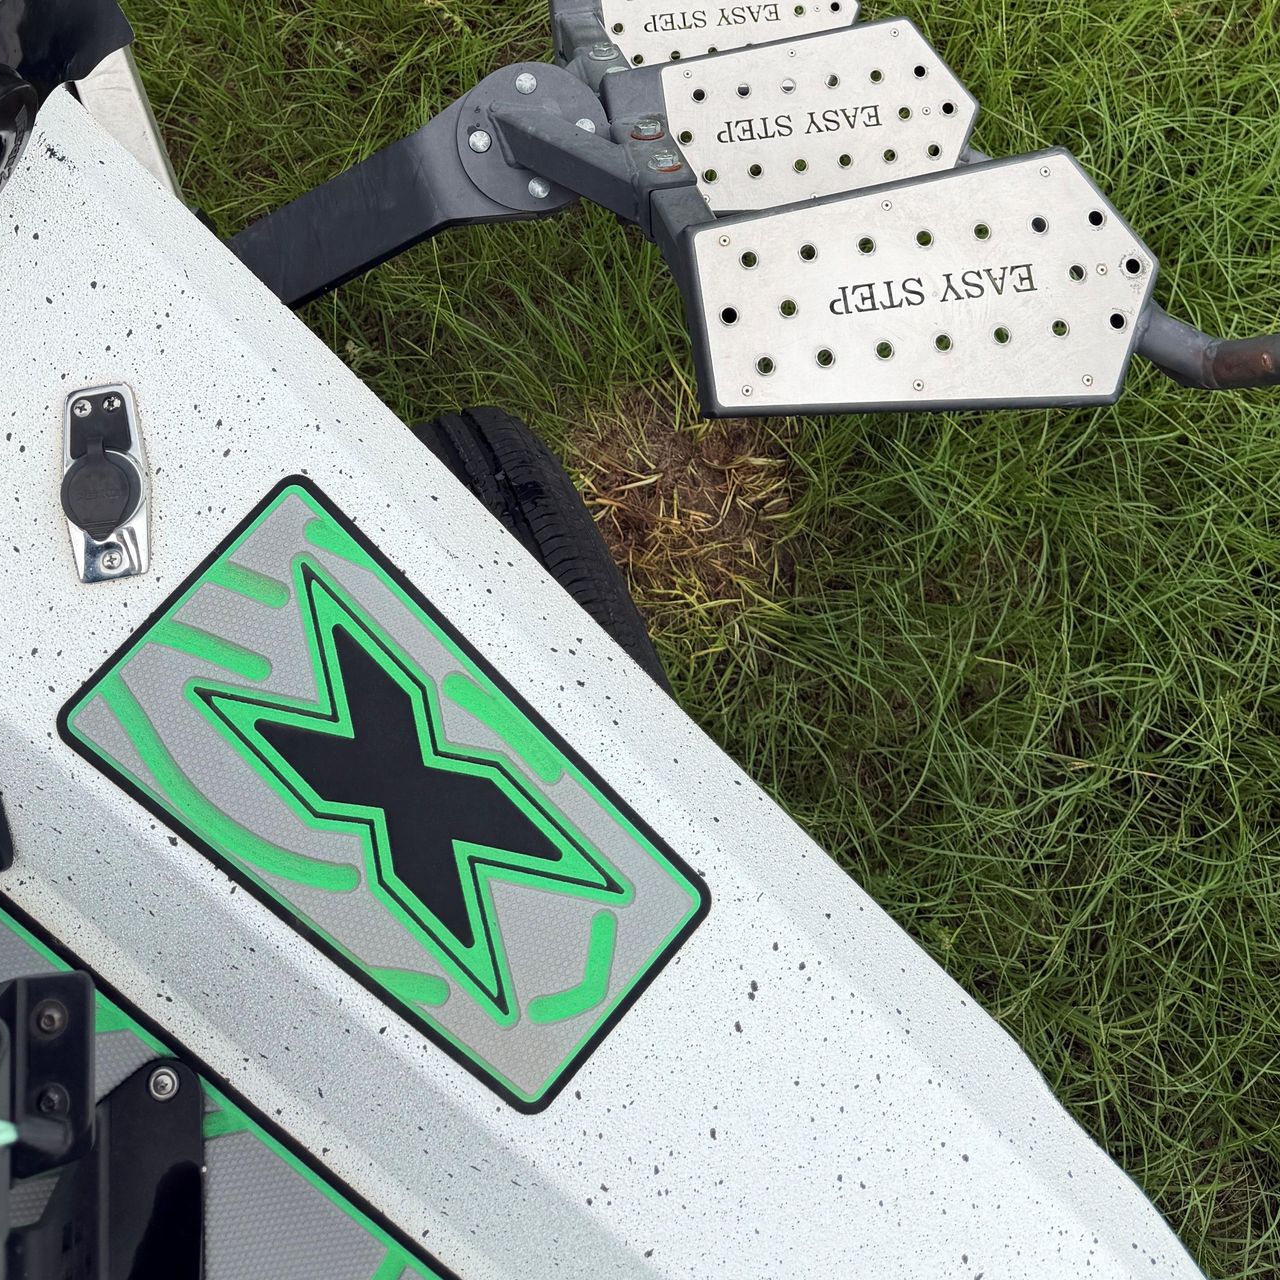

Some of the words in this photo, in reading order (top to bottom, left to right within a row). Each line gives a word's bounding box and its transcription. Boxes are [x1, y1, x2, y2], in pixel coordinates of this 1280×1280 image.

[643, 9, 707, 33] STEP
[717, 3, 781, 28] EASY
[716, 113, 793, 144] STEP
[804, 104, 883, 135] EASY
[829, 276, 925, 316] STEP
[940, 263, 1038, 303] EASY
[220, 588, 600, 986] X
